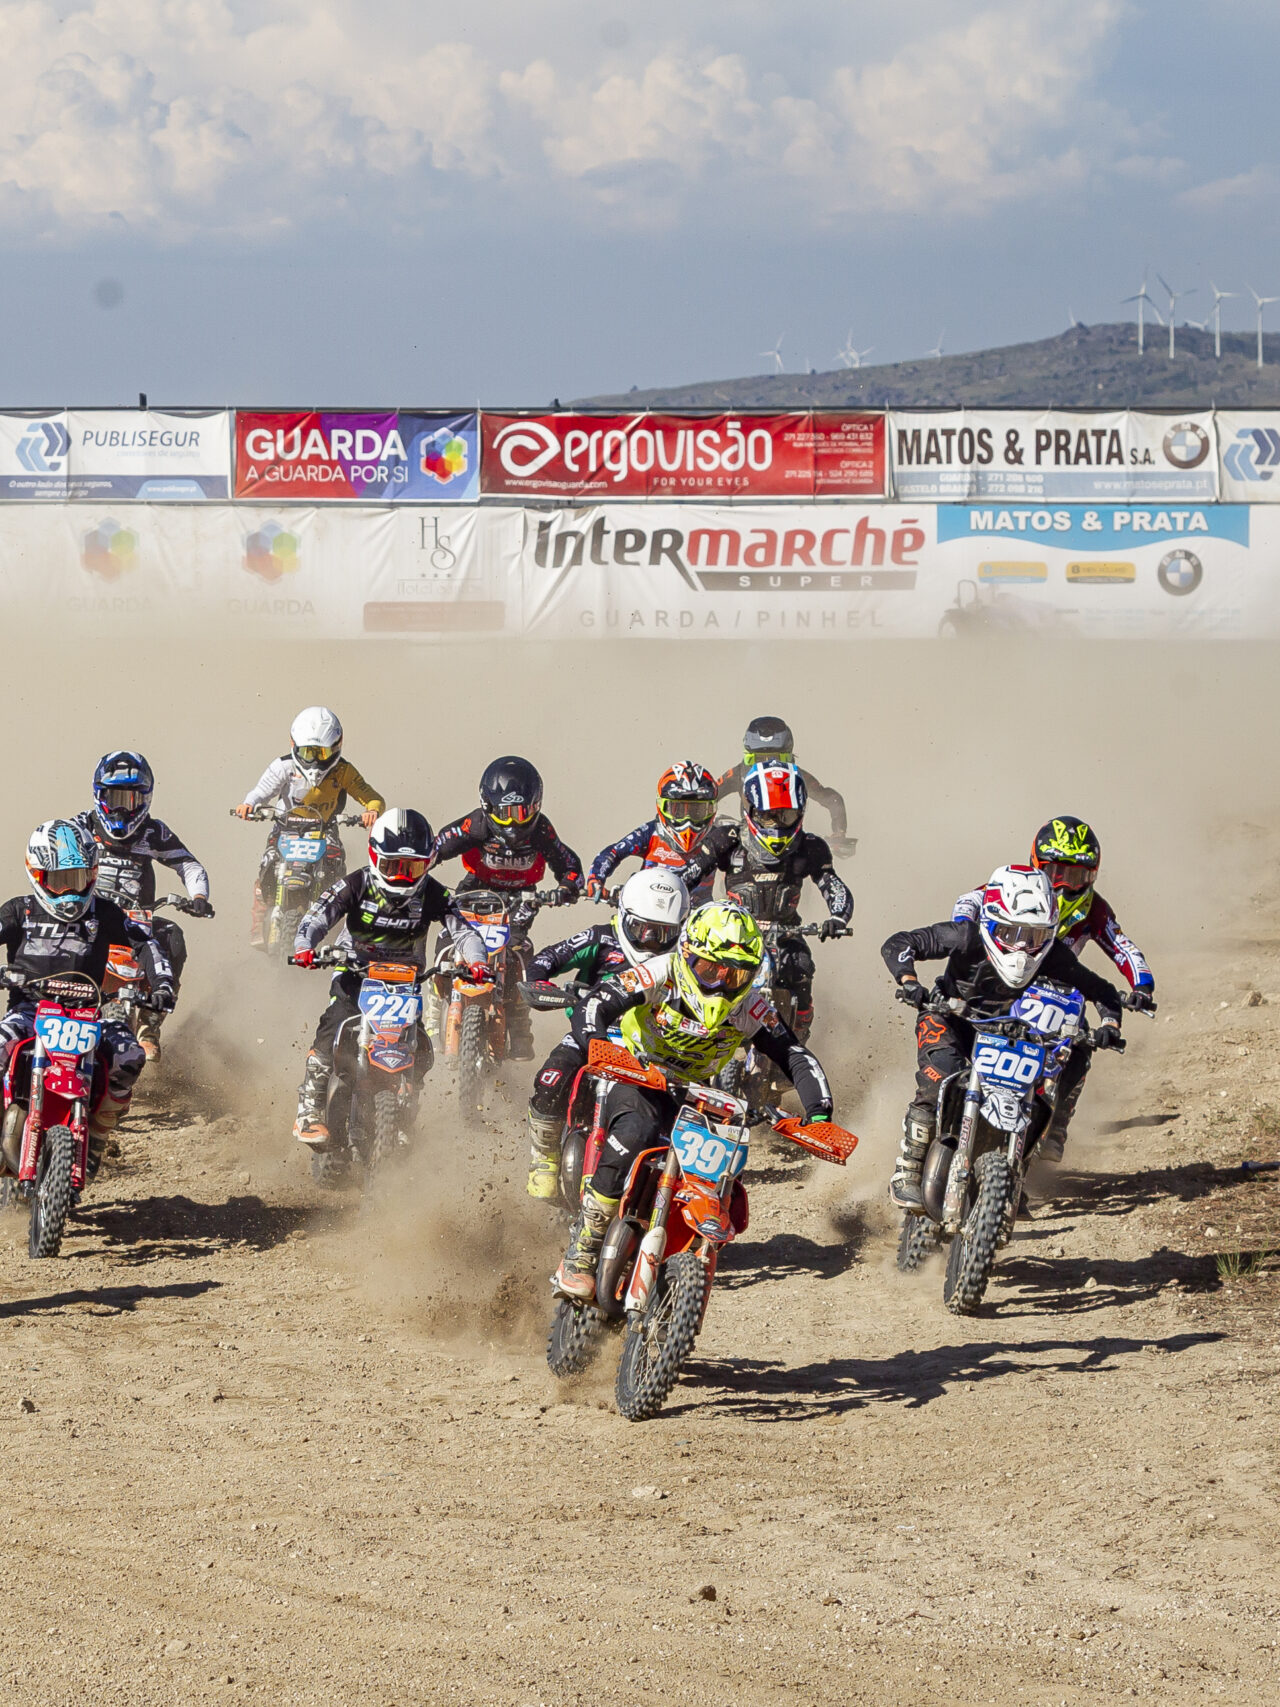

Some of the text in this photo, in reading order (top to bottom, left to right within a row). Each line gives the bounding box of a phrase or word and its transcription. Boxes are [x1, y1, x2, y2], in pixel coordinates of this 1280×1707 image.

[82, 430, 200, 447] PUBLISEGUR
[245, 428, 408, 461] GUARDA
[897, 428, 1155, 466] MATOS & PRATA S.A.
[564, 421, 773, 483] ergovisão
[245, 465, 408, 483] A GUARDA POR SI
[653, 476, 750, 486] FOR YOUR EYES
[970, 510, 1209, 532] MATOS & PRATA
[738, 575, 874, 587] SUPER
[228, 599, 316, 616] GUARDA
[485, 853, 532, 867] KENNY
[374, 916, 420, 930] SHOT
[538, 995, 566, 1004] CIRCUIT
[366, 994, 419, 1024] 224
[41, 1018, 98, 1053] 385
[974, 1047, 1040, 1084] 200
[923, 1066, 943, 1083] FOX
